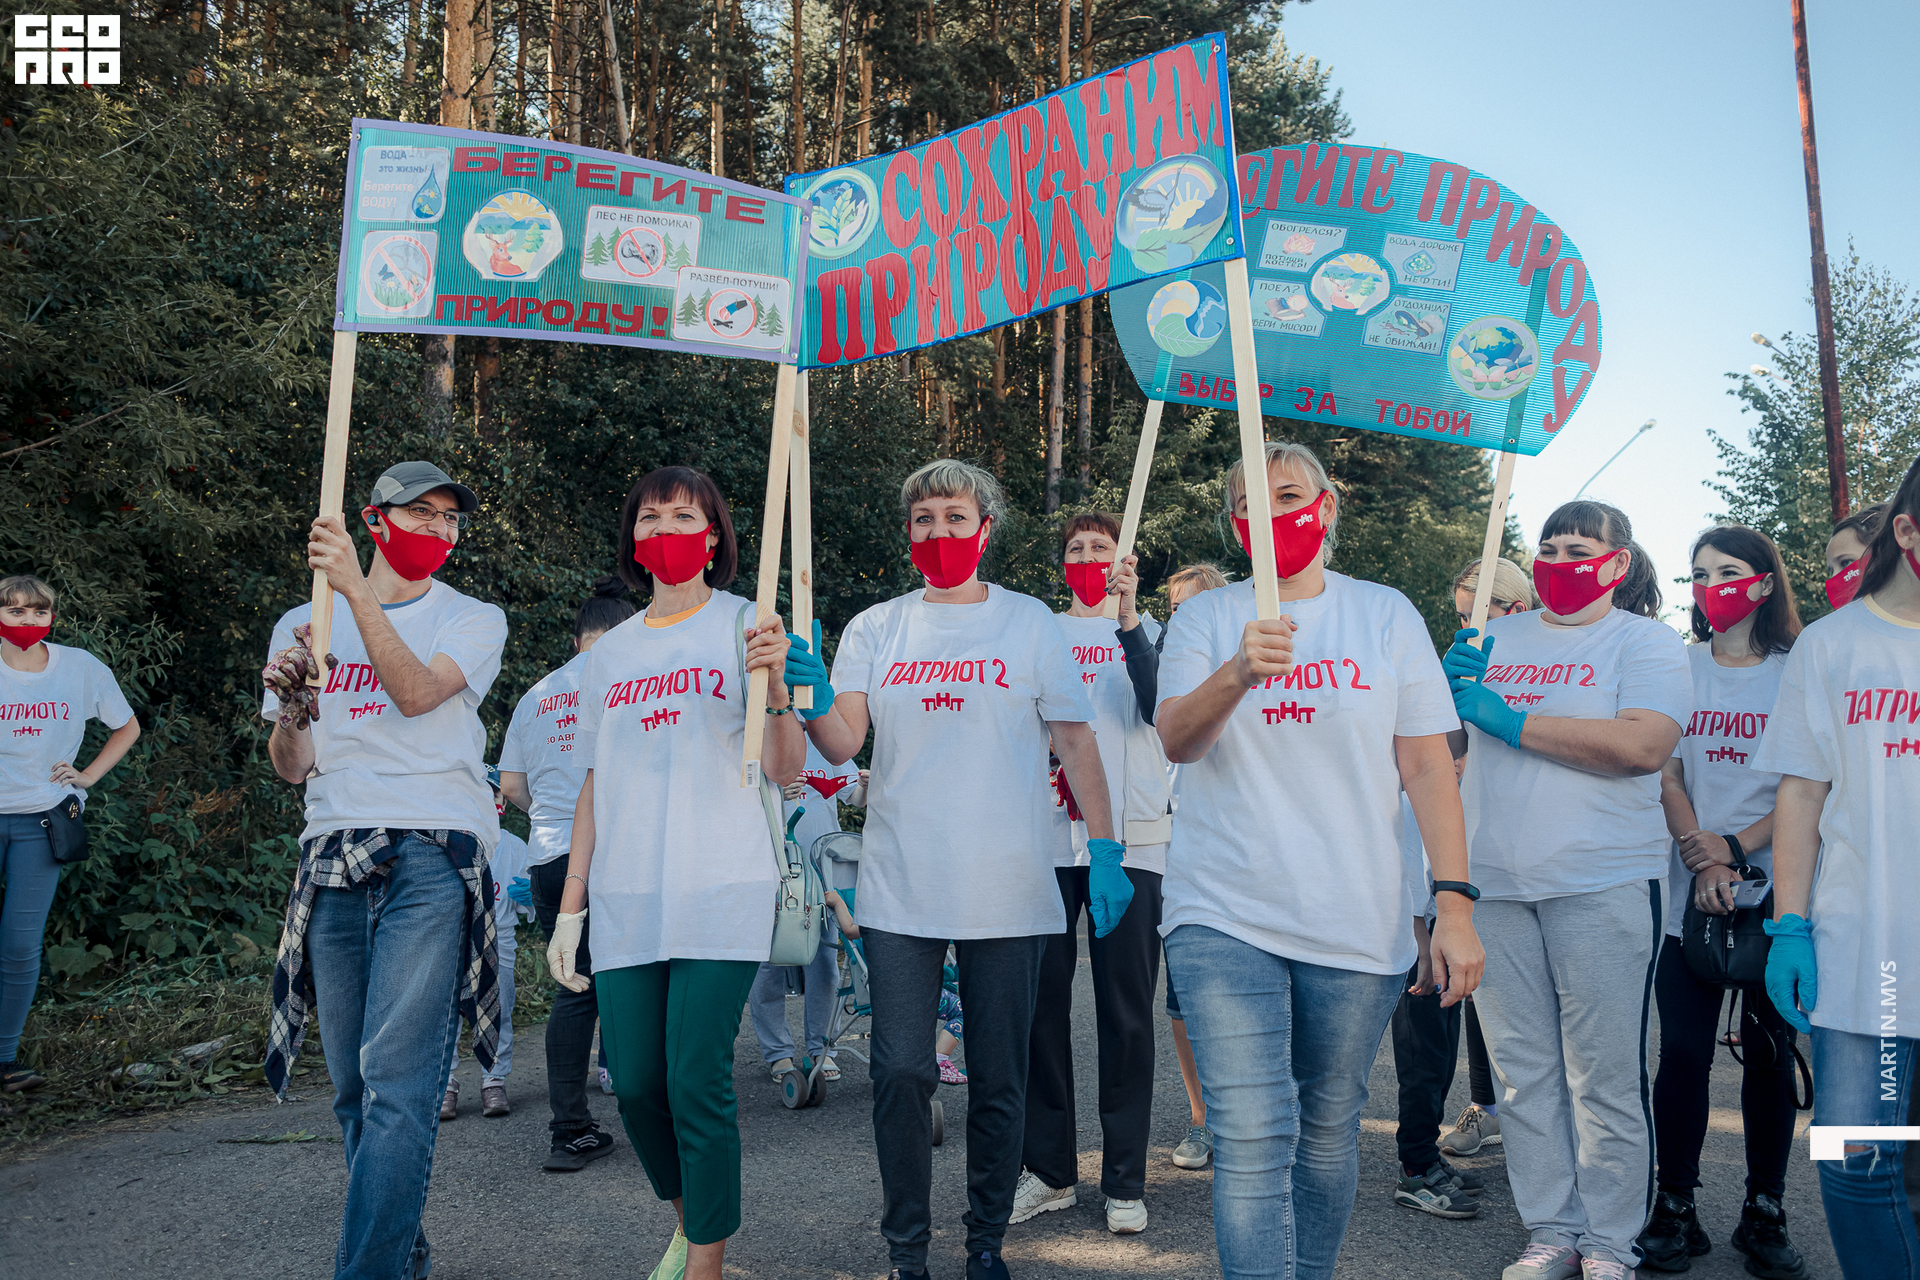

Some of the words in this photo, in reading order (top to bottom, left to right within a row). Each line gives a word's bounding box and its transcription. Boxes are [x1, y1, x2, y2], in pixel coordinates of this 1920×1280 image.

[881, 40, 1225, 249] СОХРАНИМ
[380, 150, 407, 160] ВОДА
[453, 146, 766, 225] БЕРЕГИТЕ
[362, 196, 397, 209] ВОДУ!
[595, 211, 617, 221] ЛЕС
[619, 214, 634, 223] НЕ
[1271, 222, 1342, 238] ОБОГРЕЛСЯ?
[1389, 237, 1416, 247] ВОДА
[1419, 241, 1460, 252] ДОРОЖЕ
[817, 173, 1121, 364] ПРИРОДУ
[1259, 282, 1301, 294] ПОЕЛ?
[1404, 274, 1451, 288] НЕФТИ!
[1393, 299, 1449, 314] ОТДОХНУЛ?
[1416, 161, 1602, 433] ПРИРОДУ
[435, 294, 669, 338] ПРИРОДУ!
[1252, 319, 1277, 328] БЕРИ
[1368, 334, 1381, 343] НЕ
[1384, 336, 1437, 351] ОБИЖАЙ!
[1178, 372, 1274, 403] ВЫБР
[1293, 386, 1338, 416] ЗА
[1374, 398, 1473, 438] ТОБОЙ
[880, 659, 987, 690] ПАТРИОТ
[991, 658, 1010, 690] 2
[1342, 657, 1372, 691] 2
[1482, 663, 1577, 686] ПАТРИОТ
[1578, 663, 1596, 687] 2
[602, 667, 703, 714] ПАТРИОТ
[708, 668, 727, 701] 2
[1503, 691, 1545, 706] ТНТ
[60, 702, 70, 720] 2
[349, 701, 387, 720] ТНТ
[921, 692, 965, 712] ТНТ
[556, 713, 578, 729] ТН
[640, 708, 681, 732] ТНТ
[1261, 701, 1316, 725] ТНТ
[12, 726, 43, 738] ТНТ
[1705, 746, 1748, 765] ТНТ
[1883, 737, 1920, 759] ТН
